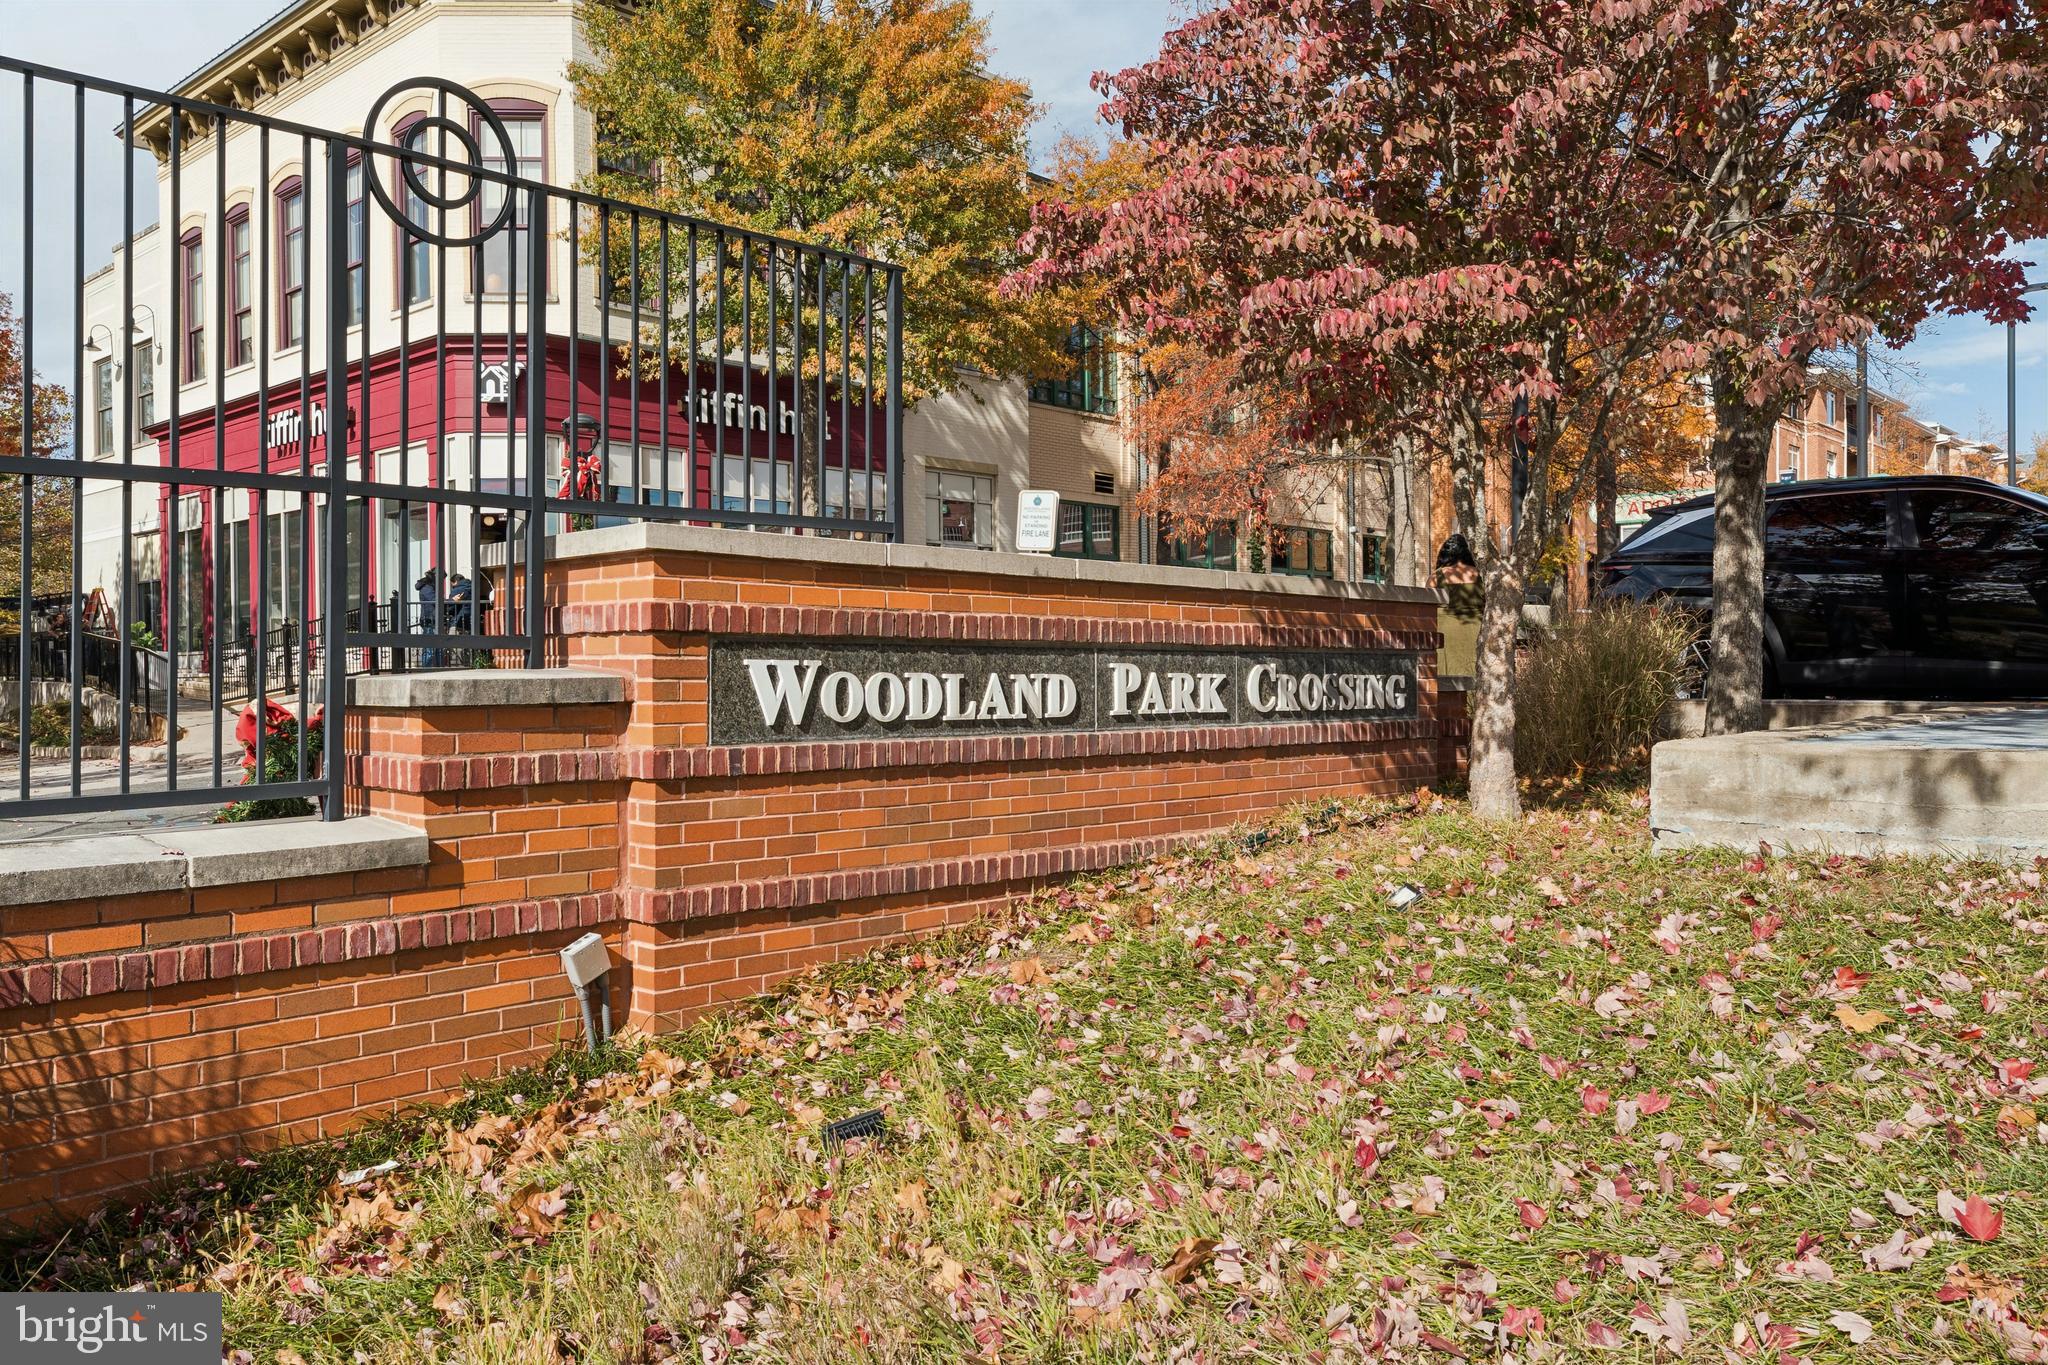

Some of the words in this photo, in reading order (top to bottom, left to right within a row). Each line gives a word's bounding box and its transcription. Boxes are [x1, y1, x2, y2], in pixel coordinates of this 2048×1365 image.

[1021, 529, 1034, 537] FIRE
[1034, 530, 1049, 538] LANE
[743, 658, 1078, 727] WOODLAND
[1109, 662, 1228, 717] PARK
[1246, 662, 1407, 714] CROSSING
